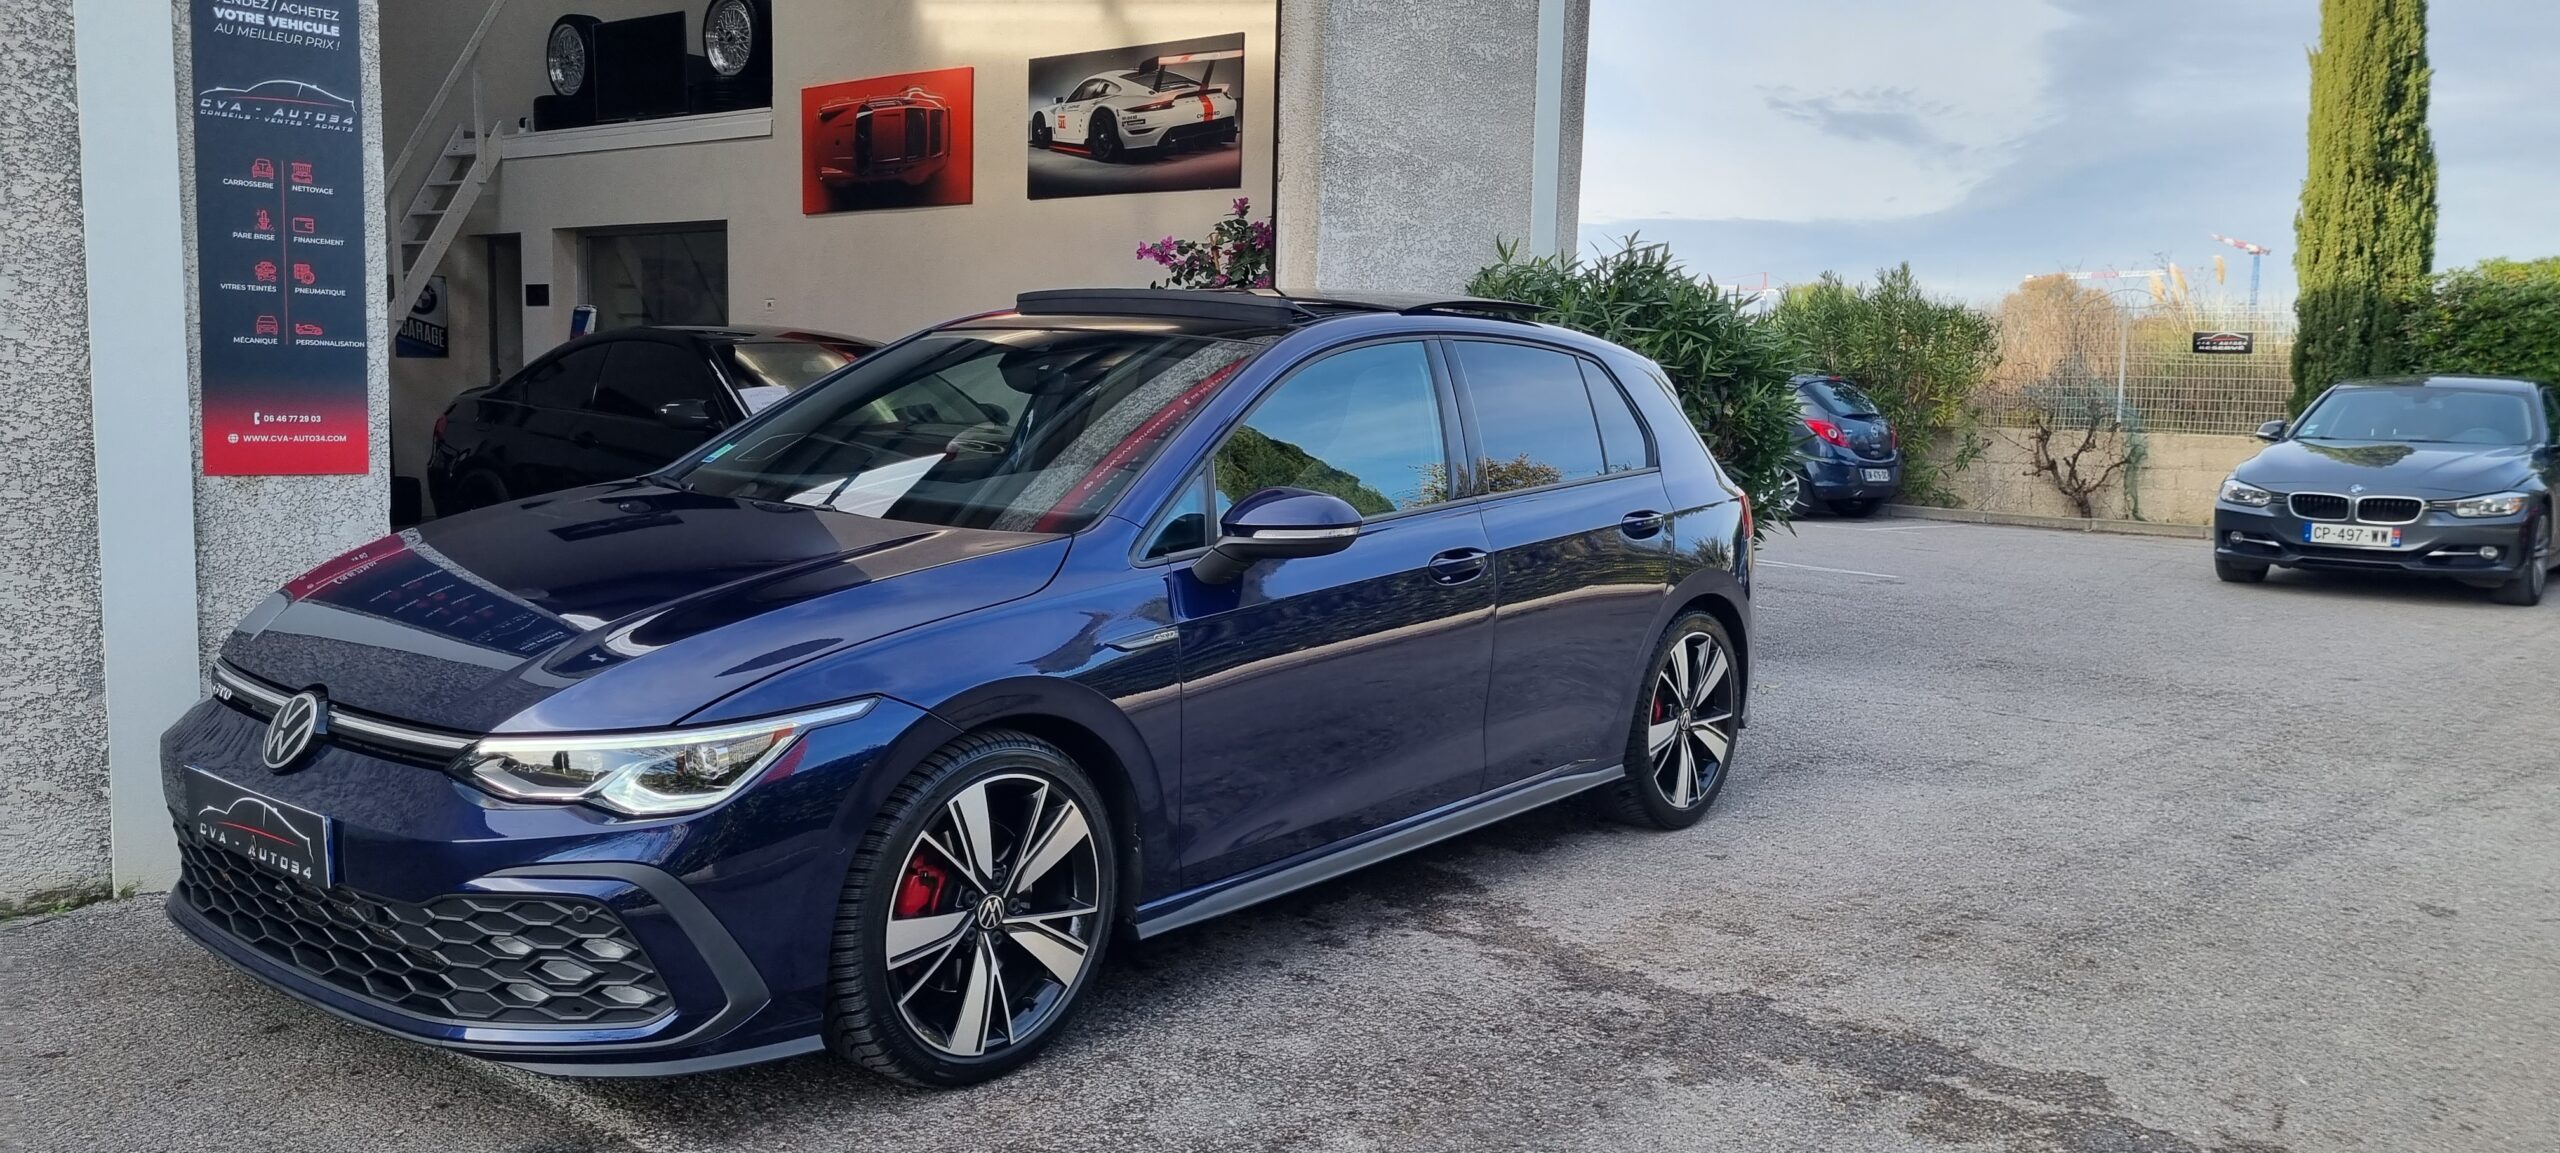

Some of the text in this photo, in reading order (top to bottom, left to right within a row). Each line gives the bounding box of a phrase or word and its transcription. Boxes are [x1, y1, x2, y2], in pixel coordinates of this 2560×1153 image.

[279, 2, 340, 21] ACHETEZ
[213, 6, 340, 37] VOTRE VEHICULE
[213, 23, 234, 35] AU
[237, 26, 303, 45] MEILLEUR
[305, 36, 335, 50] PRIX
[200, 98, 242, 111] CVA
[273, 108, 354, 125] AUTO34
[200, 109, 251, 120] CONSEILS
[264, 116, 302, 126] VENTES
[314, 123, 353, 132] ACHATS
[222, 178, 274, 189] CARROSSERIE
[292, 185, 333, 195] NETTOYAGE
[232, 231, 276, 241] PARE BRISE
[293, 236, 344, 246] FINANCEMENT
[220, 283, 246, 291] VITRES
[294, 287, 346, 297] PNEUMATIQUE
[400, 320, 445, 348] GARAGE
[233, 336, 278, 345] MÉCANIQUE
[295, 339, 365, 348] PERSONNALISATION
[263, 415, 275, 423] 06
[276, 415, 287, 423] 46
[288, 415, 299, 423] 77
[310, 415, 322, 423] 03
[243, 434, 347, 443] WWW.CVA-AUTO34.COM
[212, 682, 232, 700] GTD
[199, 822, 227, 844] CVA
[248, 844, 312, 880] AUTO34
